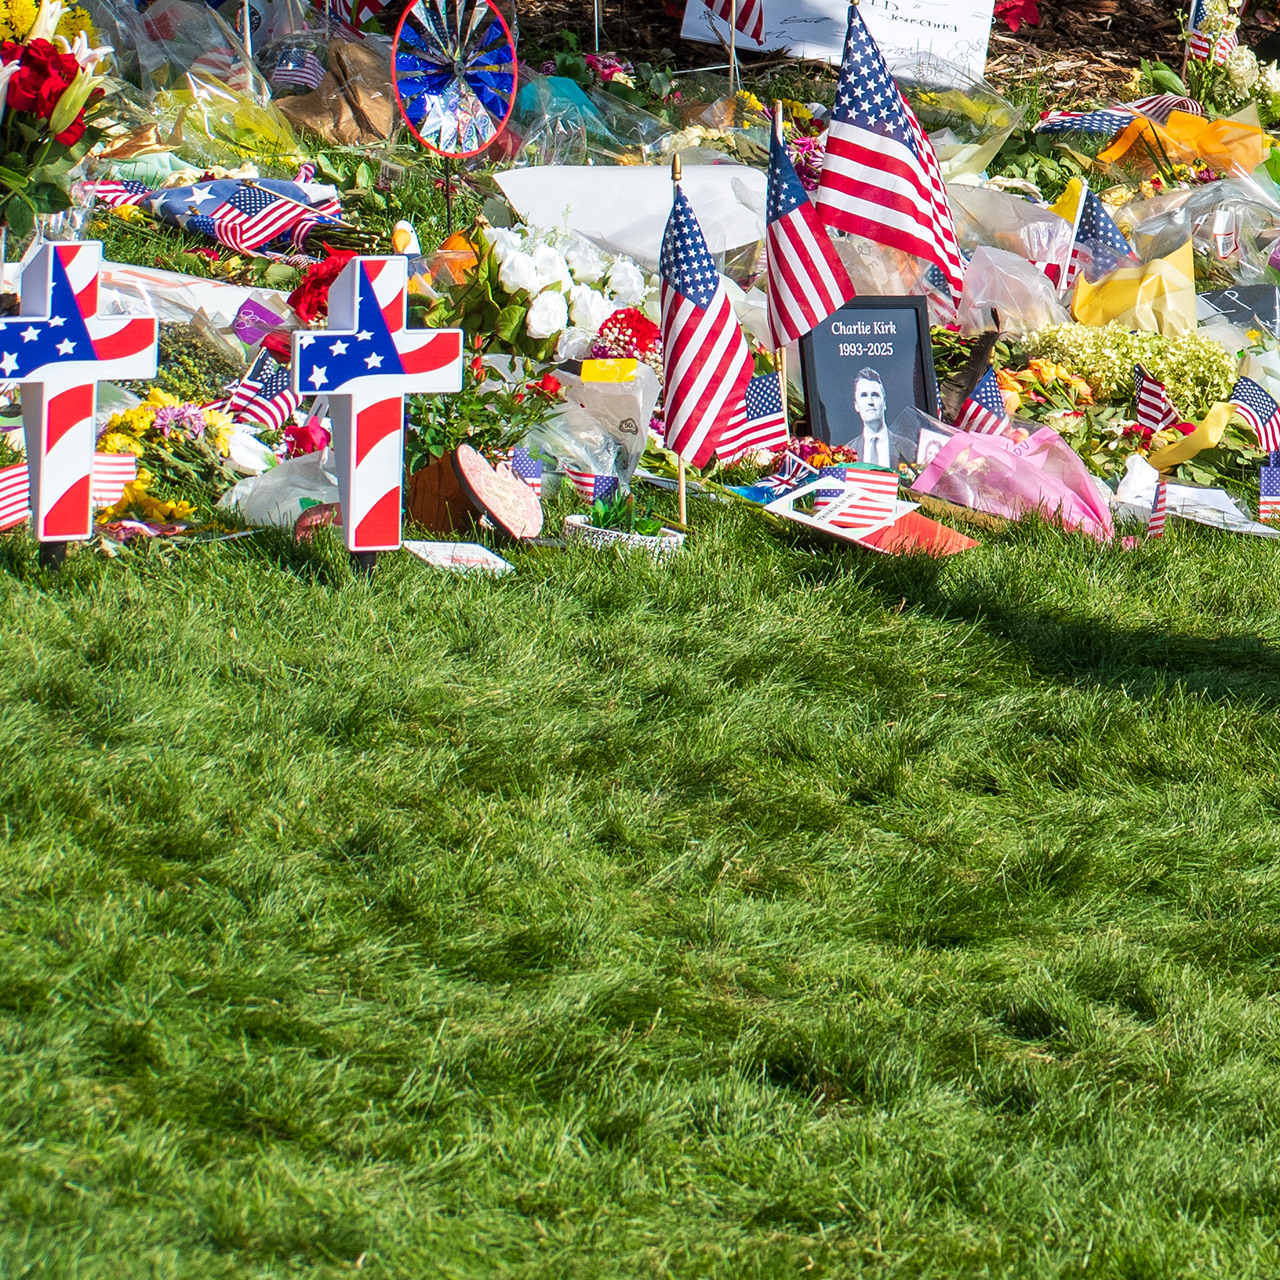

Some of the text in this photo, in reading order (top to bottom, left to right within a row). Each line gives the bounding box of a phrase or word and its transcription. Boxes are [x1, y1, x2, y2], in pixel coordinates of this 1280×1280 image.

[831, 321, 897, 335] Charlie Kirk
[839, 342, 894, 356] 1993-2025
